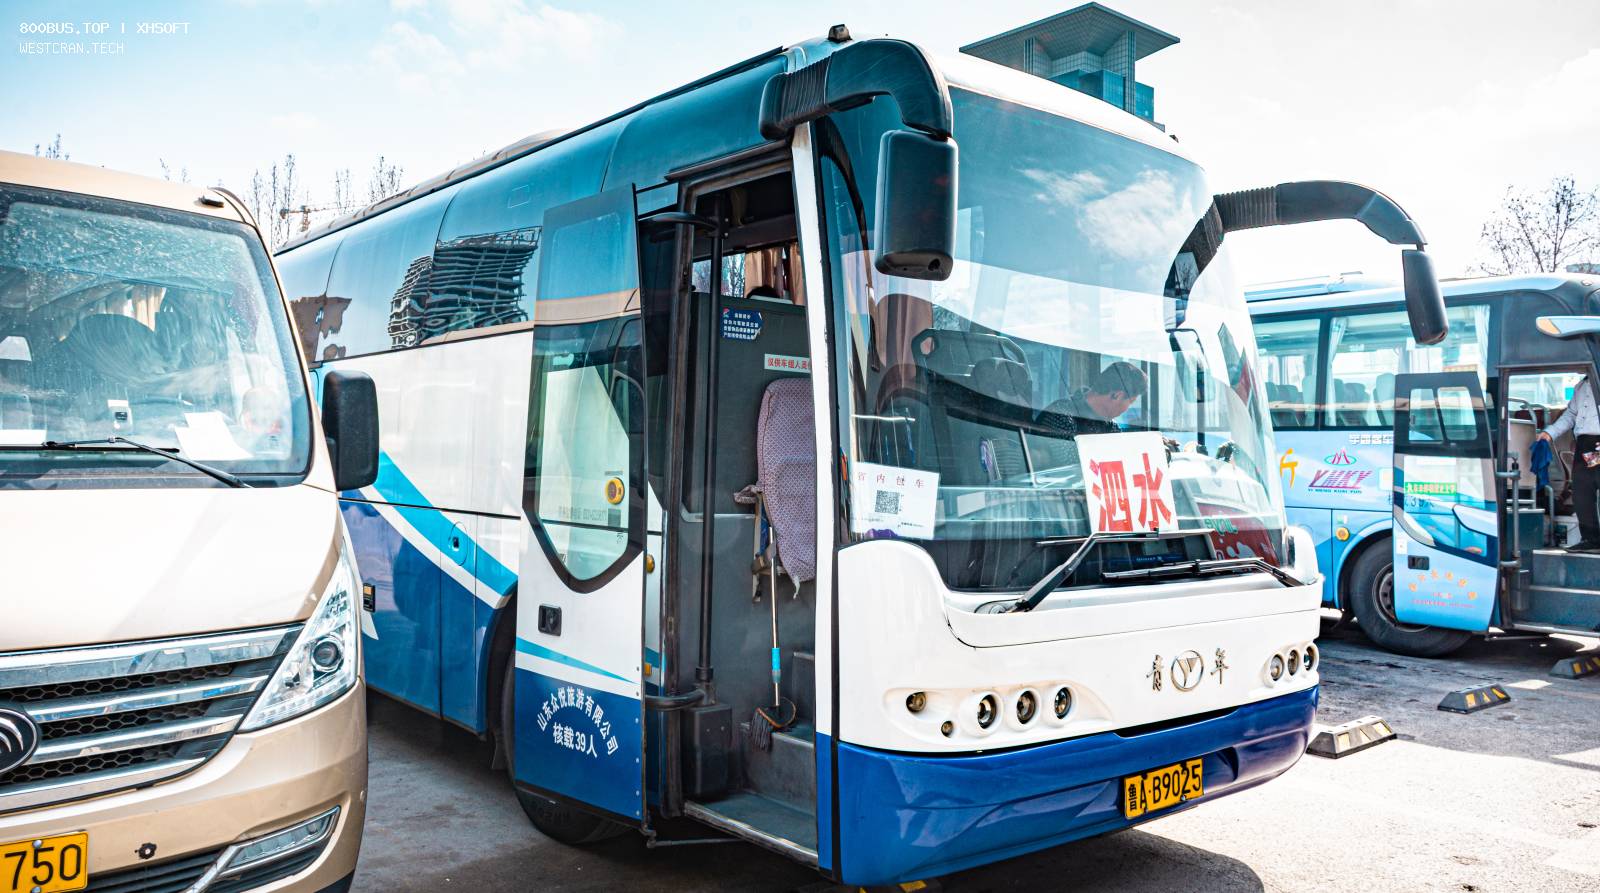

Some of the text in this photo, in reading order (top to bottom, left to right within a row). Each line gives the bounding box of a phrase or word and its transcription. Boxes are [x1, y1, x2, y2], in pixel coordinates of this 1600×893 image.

[1090, 452, 1172, 531] 泗水
[536, 686, 619, 756] 山东众悦旅游有限公司
[552, 722, 598, 758] 核载39人
[4, 843, 82, 890] 750
